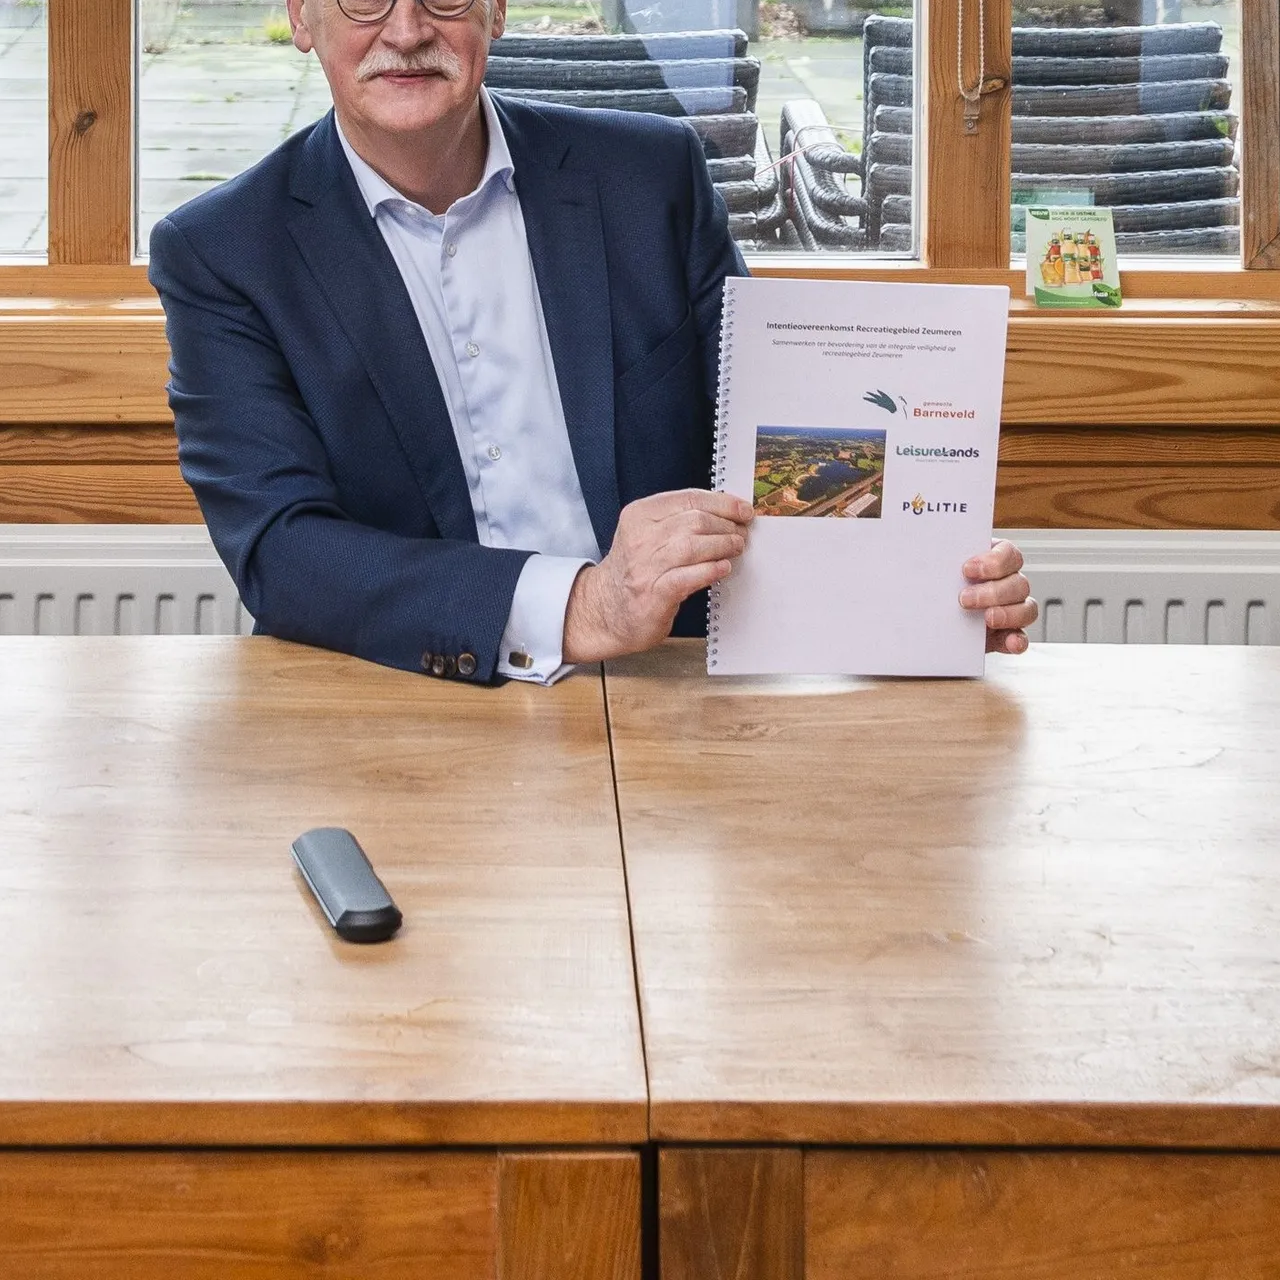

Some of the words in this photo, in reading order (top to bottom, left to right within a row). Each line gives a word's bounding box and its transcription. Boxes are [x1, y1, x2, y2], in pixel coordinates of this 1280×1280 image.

[766, 321, 854, 332] Intentieovereenkomst
[856, 324, 920, 335] Recreatiegebied
[922, 327, 962, 336] Zeumeren
[772, 339, 815, 347] Samenwerken
[827, 341, 864, 350] bevordering
[888, 343, 916, 352] integrale
[917, 344, 946, 353] veiligheid
[947, 345, 957, 353] op
[822, 350, 871, 359] recreatiegebied
[913, 408, 975, 419] Barneveld
[896, 445, 980, 458] LeisureLands
[902, 499, 967, 515] POLITIE
